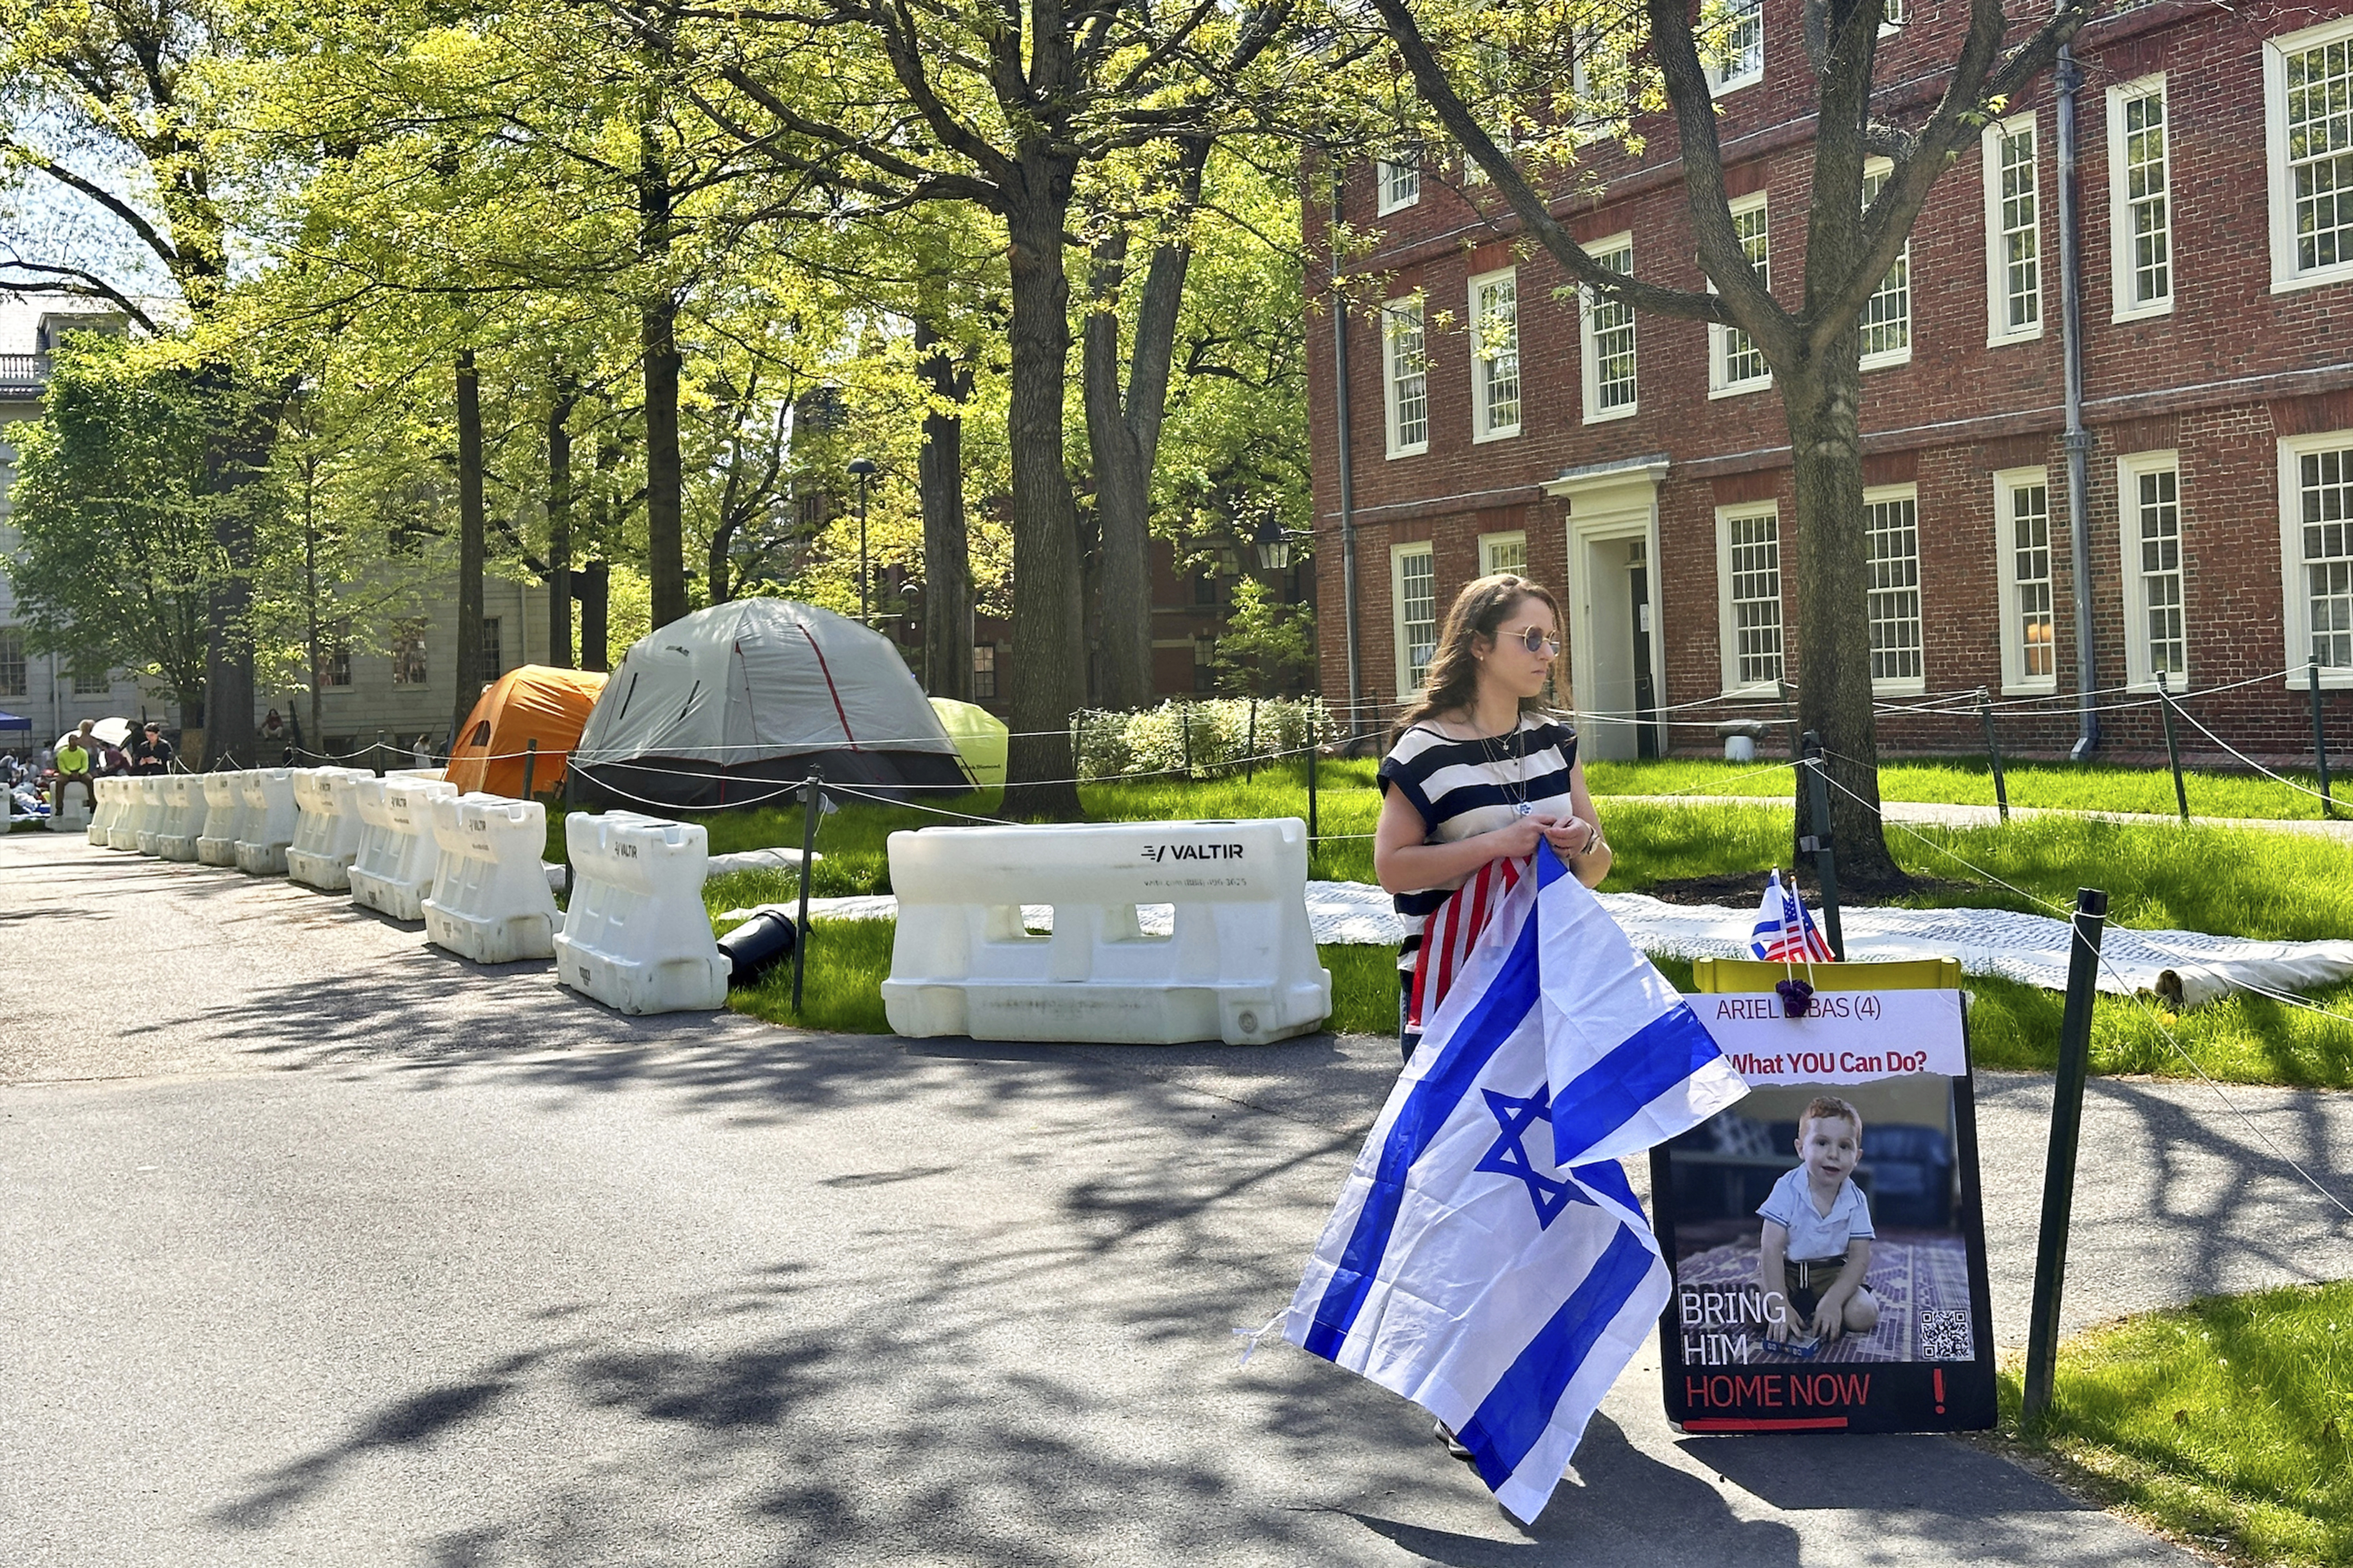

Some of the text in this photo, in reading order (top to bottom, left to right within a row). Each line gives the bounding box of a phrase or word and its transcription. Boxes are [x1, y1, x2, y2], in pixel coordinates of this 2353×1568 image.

[1171, 844, 1243, 859] VALTIR
[1717, 996, 1881, 1020] ARIEL BAS (4)
[1726, 1051, 1927, 1074] What YOU Can Do?
[1682, 1292, 1786, 1324] BRING
[1684, 1334, 1748, 1365] HIM
[1686, 1375, 1783, 1407] HOME
[1790, 1374, 1870, 1406] NOW
